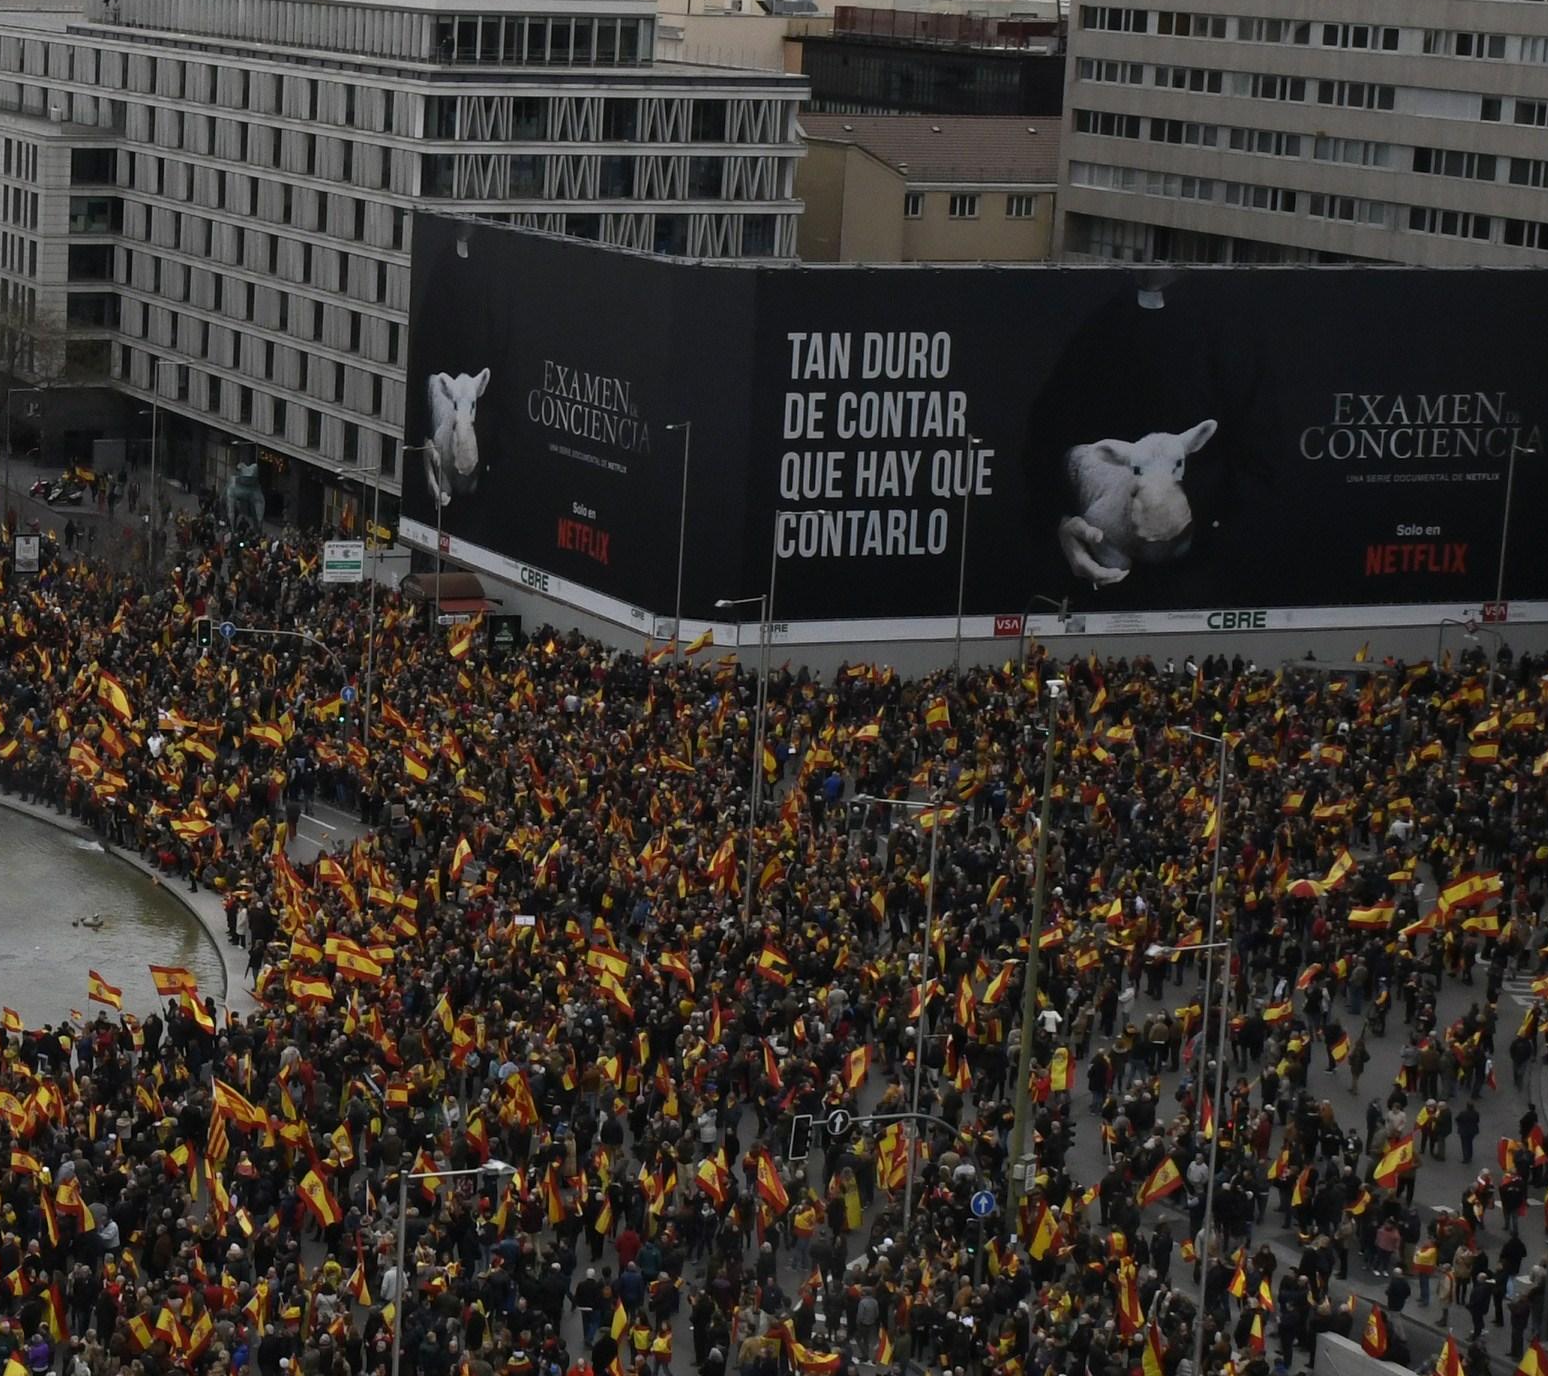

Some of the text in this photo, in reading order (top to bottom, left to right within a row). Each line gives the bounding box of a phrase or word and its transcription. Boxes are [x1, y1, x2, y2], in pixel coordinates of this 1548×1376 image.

[787, 331, 951, 380] TAN DURO
[543, 360, 631, 415] EXAMEN
[528, 389, 651, 453] CONCIENCIA
[783, 391, 967, 440] DE CONTAR
[1332, 392, 1506, 425] EXAMEN
[1300, 425, 1545, 460] CONCIENCIA
[779, 449, 995, 501] QUE HAY QUE
[1465, 473, 1500, 481] NETFLIX
[572, 502, 597, 520] Solo en
[557, 518, 610, 565] NETFLIX
[776, 508, 948, 558] CONTARLO
[1396, 524, 1441, 536] Solo en
[1365, 543, 1472, 576] NETFLIX
[521, 567, 549, 591] CBRE
[996, 619, 1020, 630] VSA
[1207, 611, 1267, 629] CBRE
